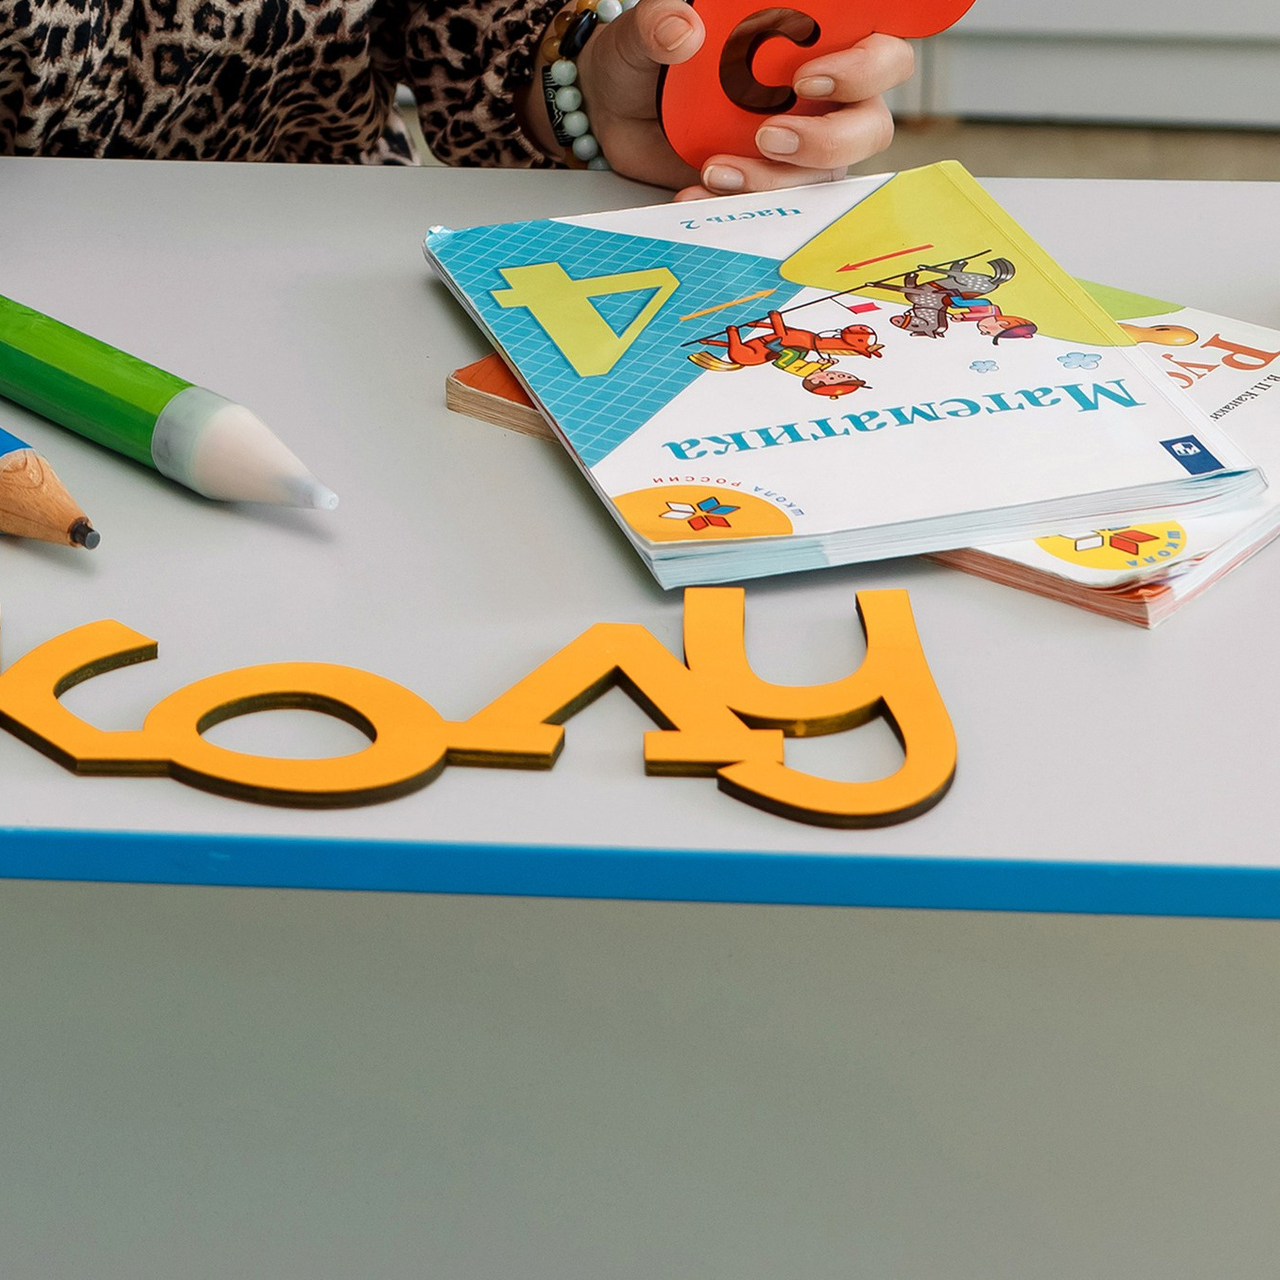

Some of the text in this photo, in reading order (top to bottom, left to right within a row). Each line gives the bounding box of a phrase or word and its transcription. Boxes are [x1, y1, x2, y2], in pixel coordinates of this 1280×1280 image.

[680, 207, 801, 230] Часть 2
[493, 261, 680, 377] 4
[662, 378, 1147, 461] Математика
[653, 476, 805, 516] ШКОЛА РОССИИ
